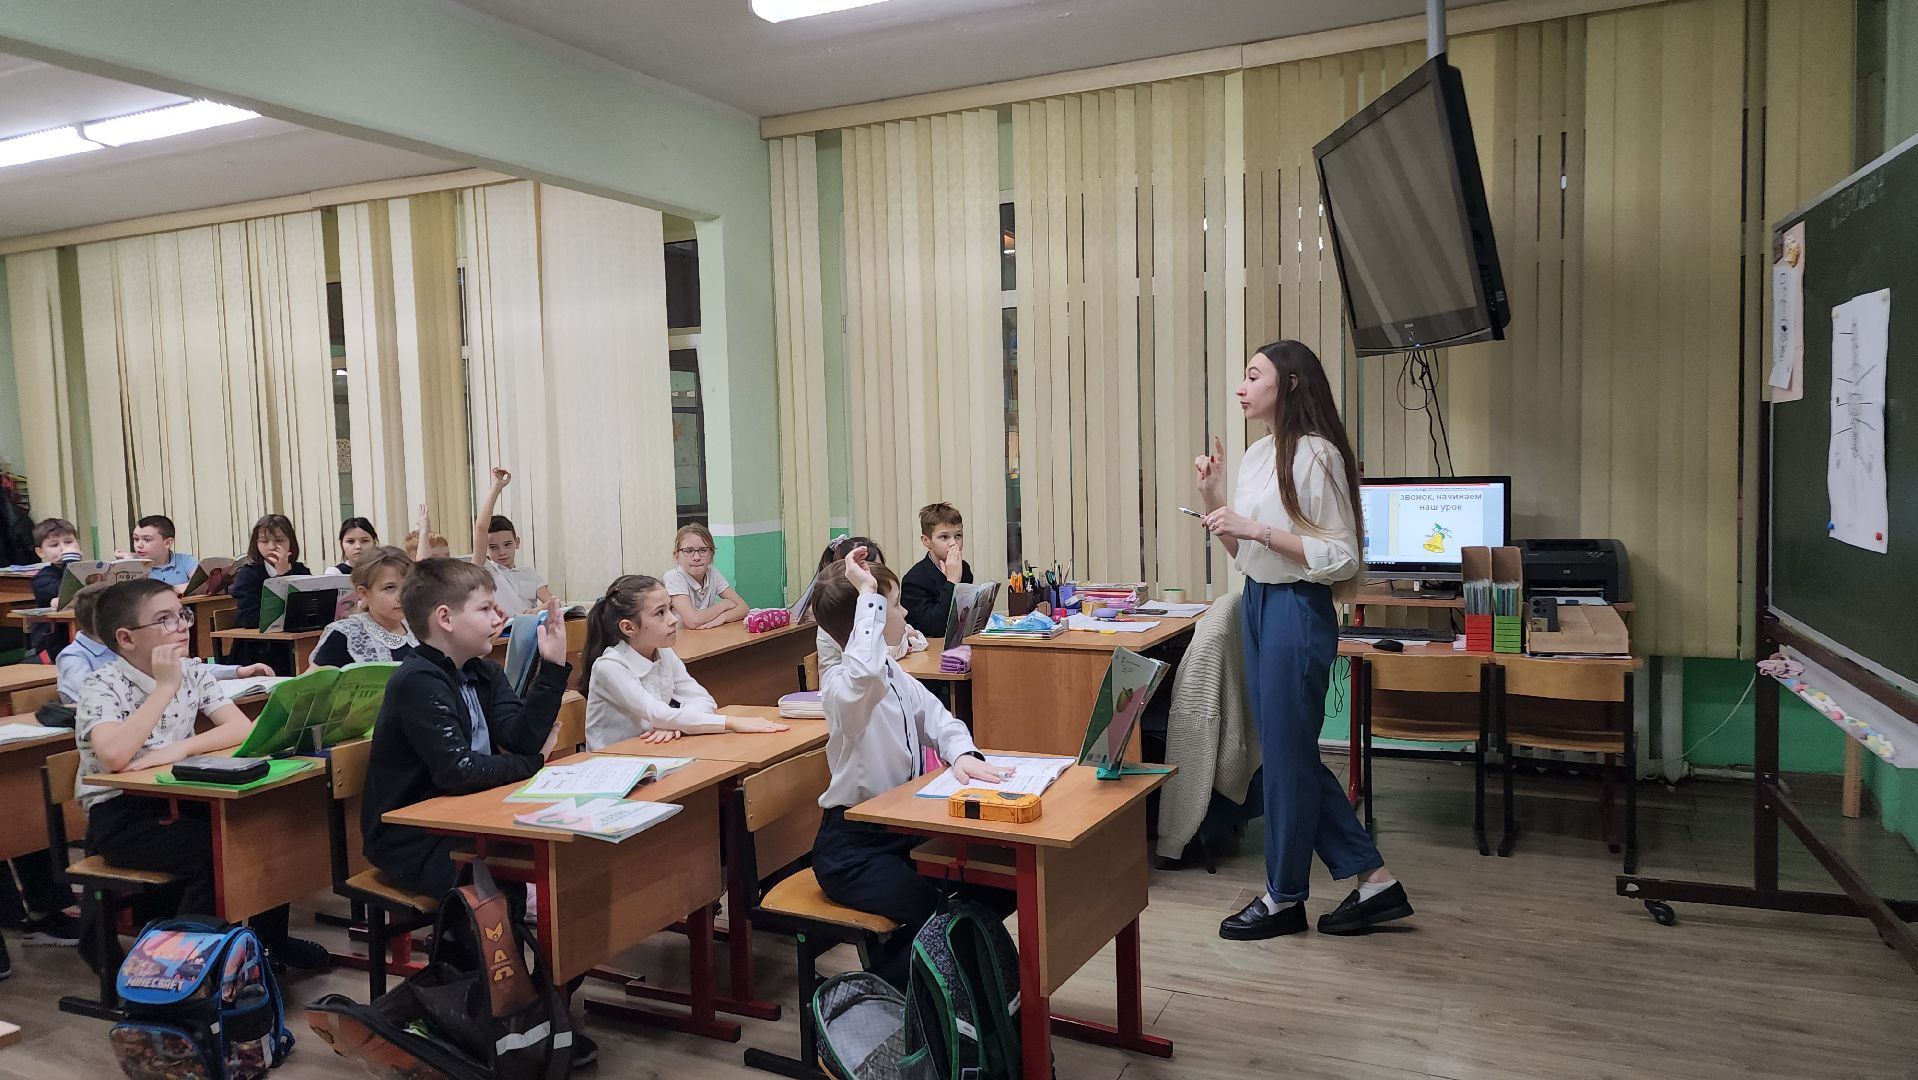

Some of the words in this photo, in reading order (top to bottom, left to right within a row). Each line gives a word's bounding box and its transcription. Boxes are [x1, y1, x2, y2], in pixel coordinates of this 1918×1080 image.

[1400, 493, 1435, 501] звонок,
[1440, 504, 1463, 512] урок
[125, 976, 185, 991] MINECRAFT
